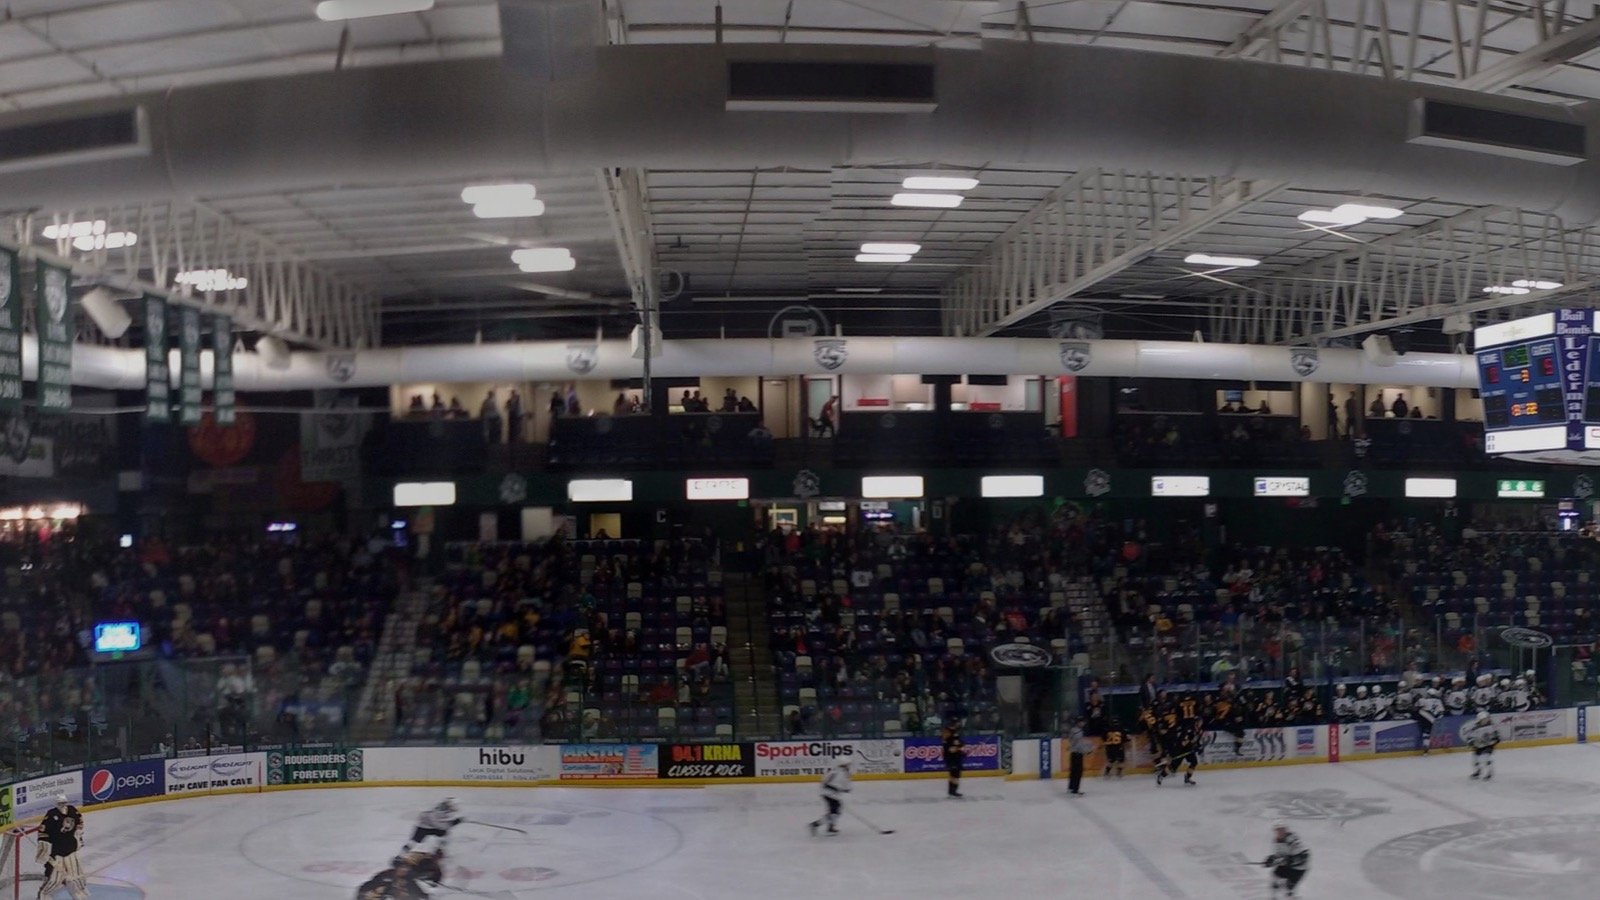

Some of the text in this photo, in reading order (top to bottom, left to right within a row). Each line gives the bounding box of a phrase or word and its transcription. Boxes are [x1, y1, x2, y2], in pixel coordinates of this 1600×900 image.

[1560, 309, 1585, 321] Bail
[1564, 337, 1586, 420] Lederman
[284, 753, 346, 765] ROUGHRIDERS
[479, 748, 525, 765] hibu
[702, 745, 742, 761] KRNA
[292, 769, 338, 780] FOREVER
[667, 764, 744, 777] CLASSIC ROCK
[116, 770, 155, 790] pepsi
[187, 780, 208, 790] CAVE
[211, 777, 253, 788] FAN CAVE
